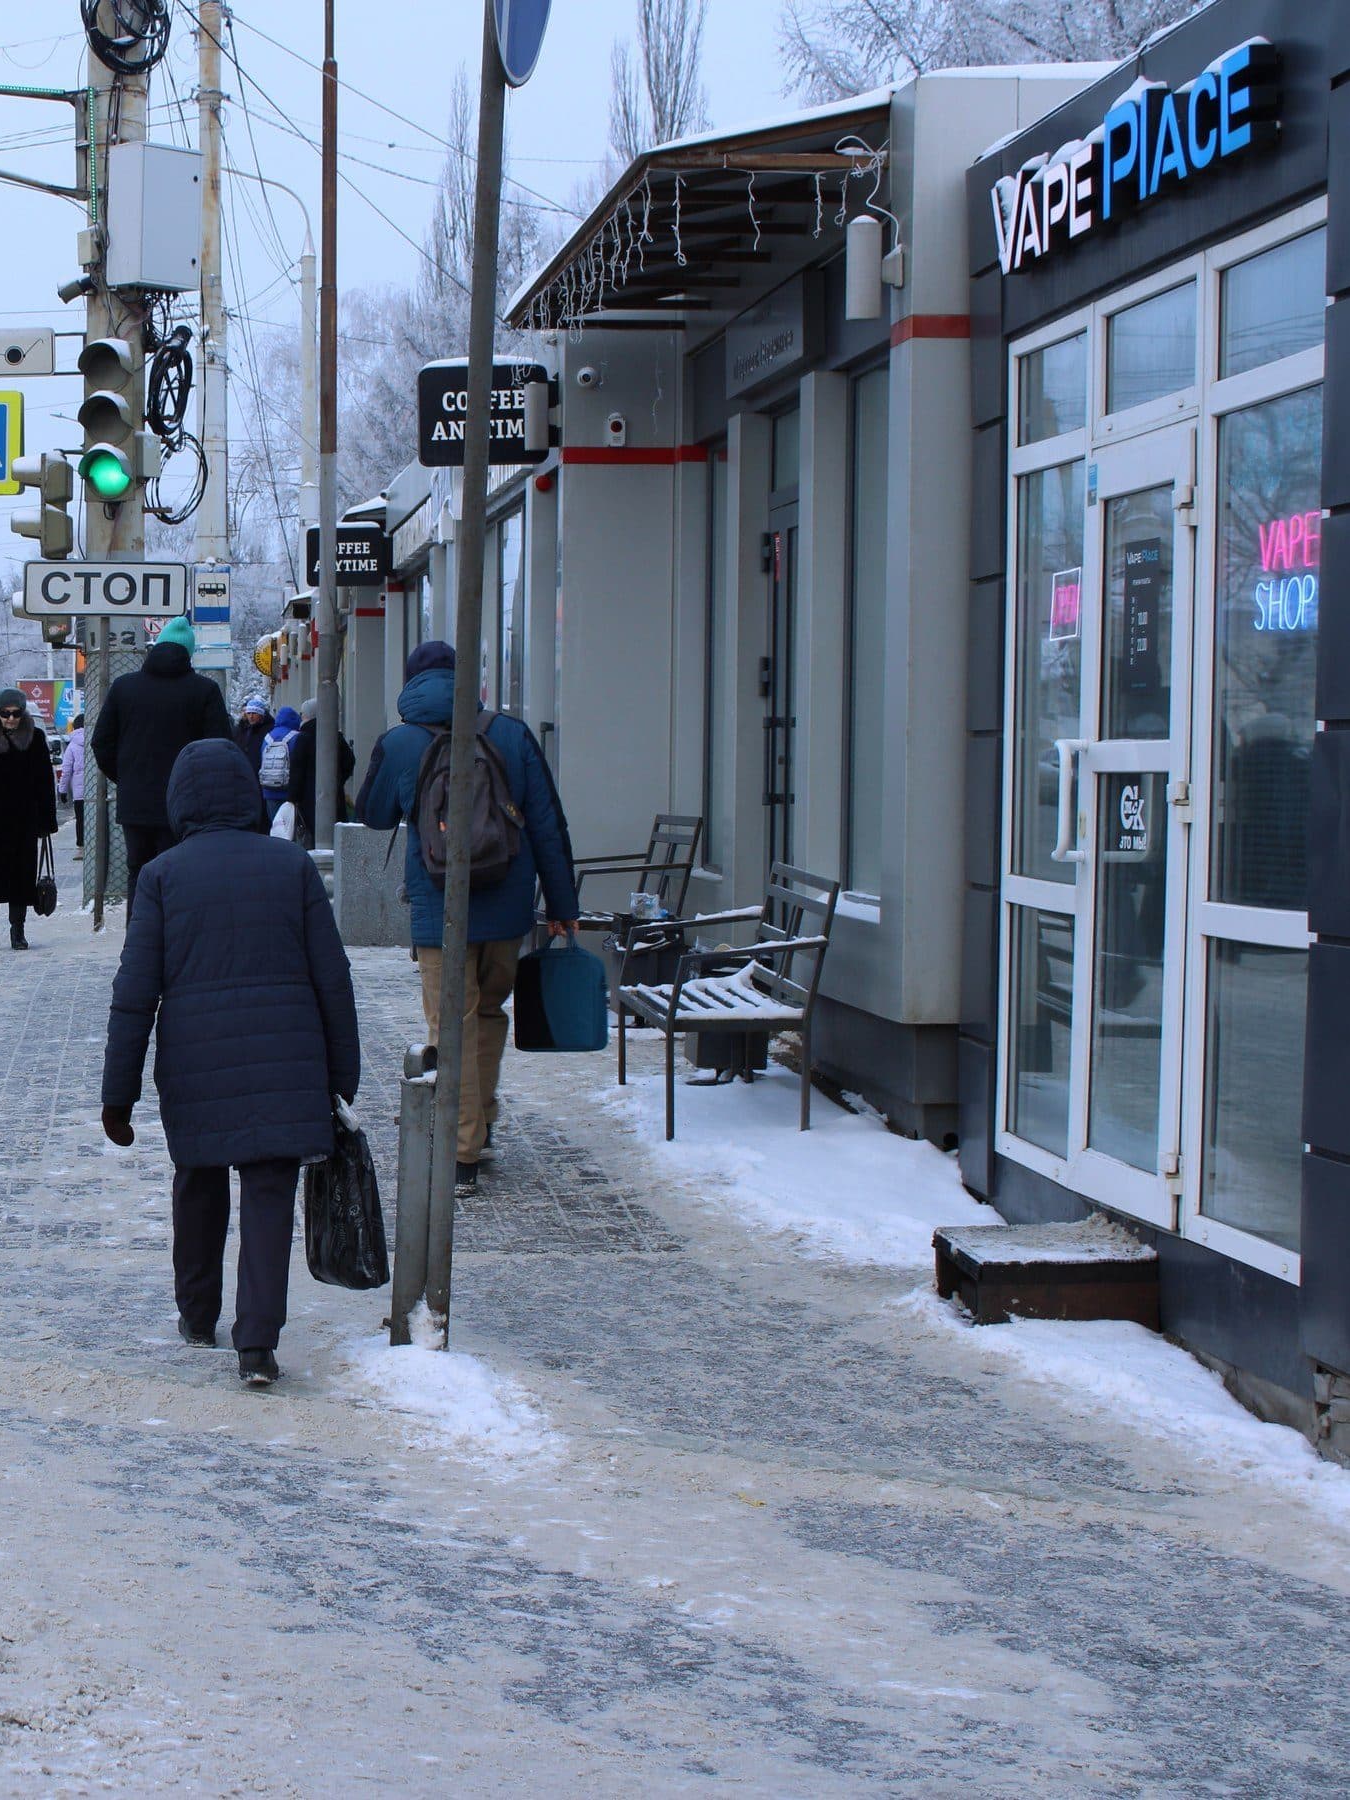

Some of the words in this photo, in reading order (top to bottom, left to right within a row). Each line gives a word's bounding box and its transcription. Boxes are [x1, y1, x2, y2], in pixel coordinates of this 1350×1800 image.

[991, 143, 1092, 276] VAPE
[442, 390, 525, 412] COFEE
[431, 419, 525, 440] ANIM
[335, 542, 370, 554] FFEE
[1259, 511, 1321, 572] VAPE
[313, 559, 378, 572] AYTIME
[41, 571, 171, 606] СТОП
[1254, 575, 1315, 630] SHOP
